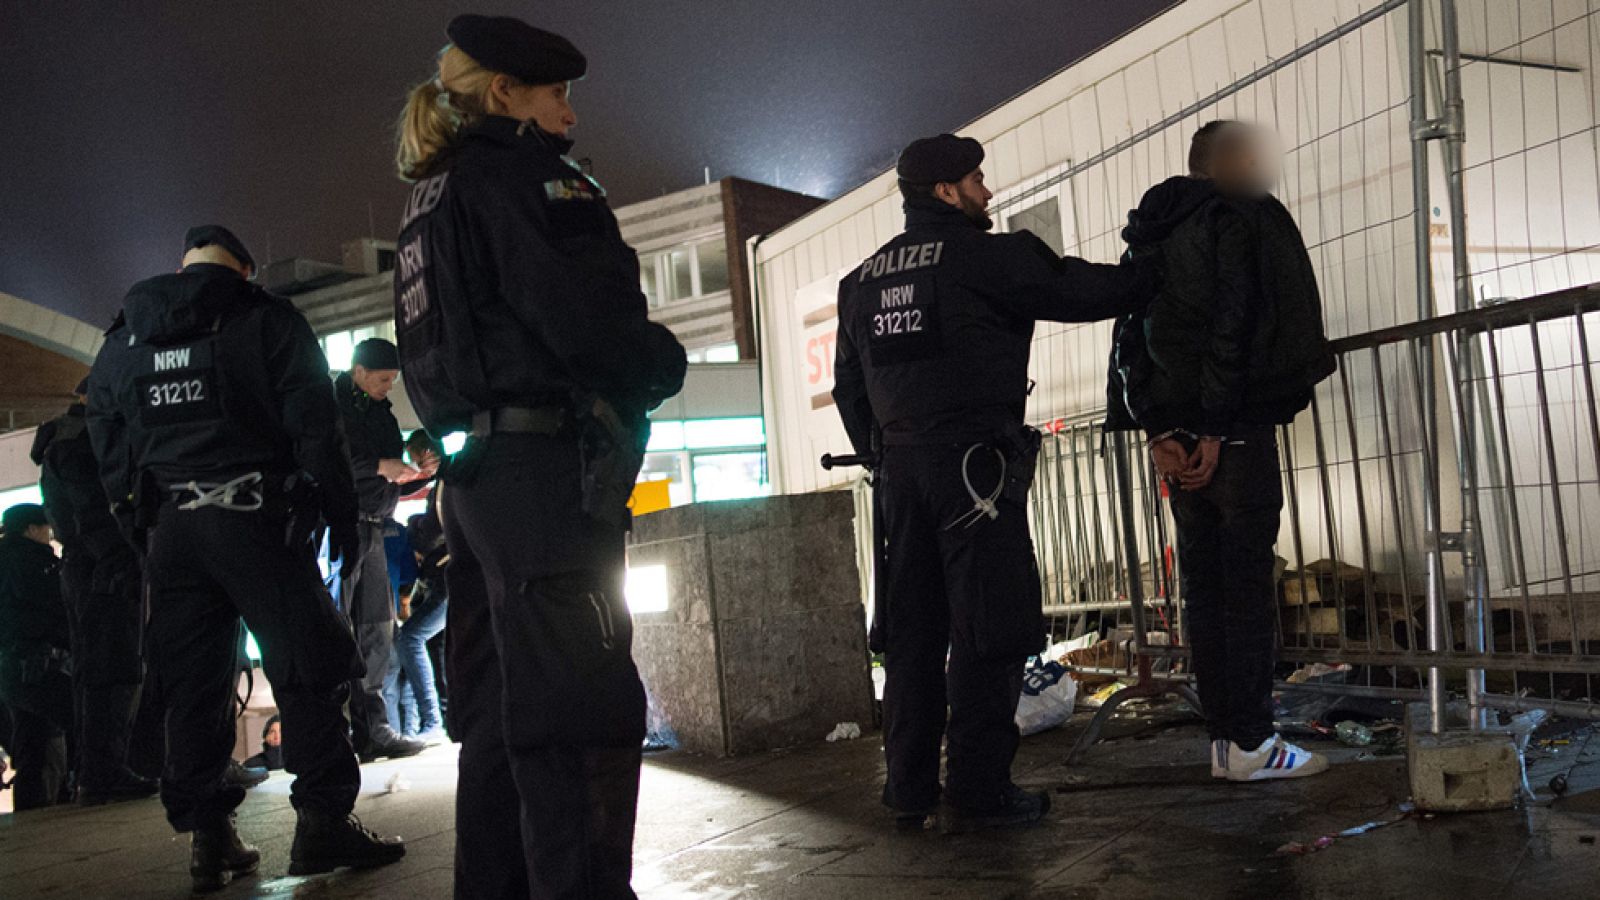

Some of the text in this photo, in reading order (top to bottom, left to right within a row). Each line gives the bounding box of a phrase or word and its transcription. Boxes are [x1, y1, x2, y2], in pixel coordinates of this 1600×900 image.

[859, 241, 943, 282] POLIZEI
[881, 284, 915, 309] NRW
[873, 309, 923, 336] 31212
[154, 348, 191, 372] NRW
[806, 330, 837, 385] ST
[149, 379, 204, 406] 31212
